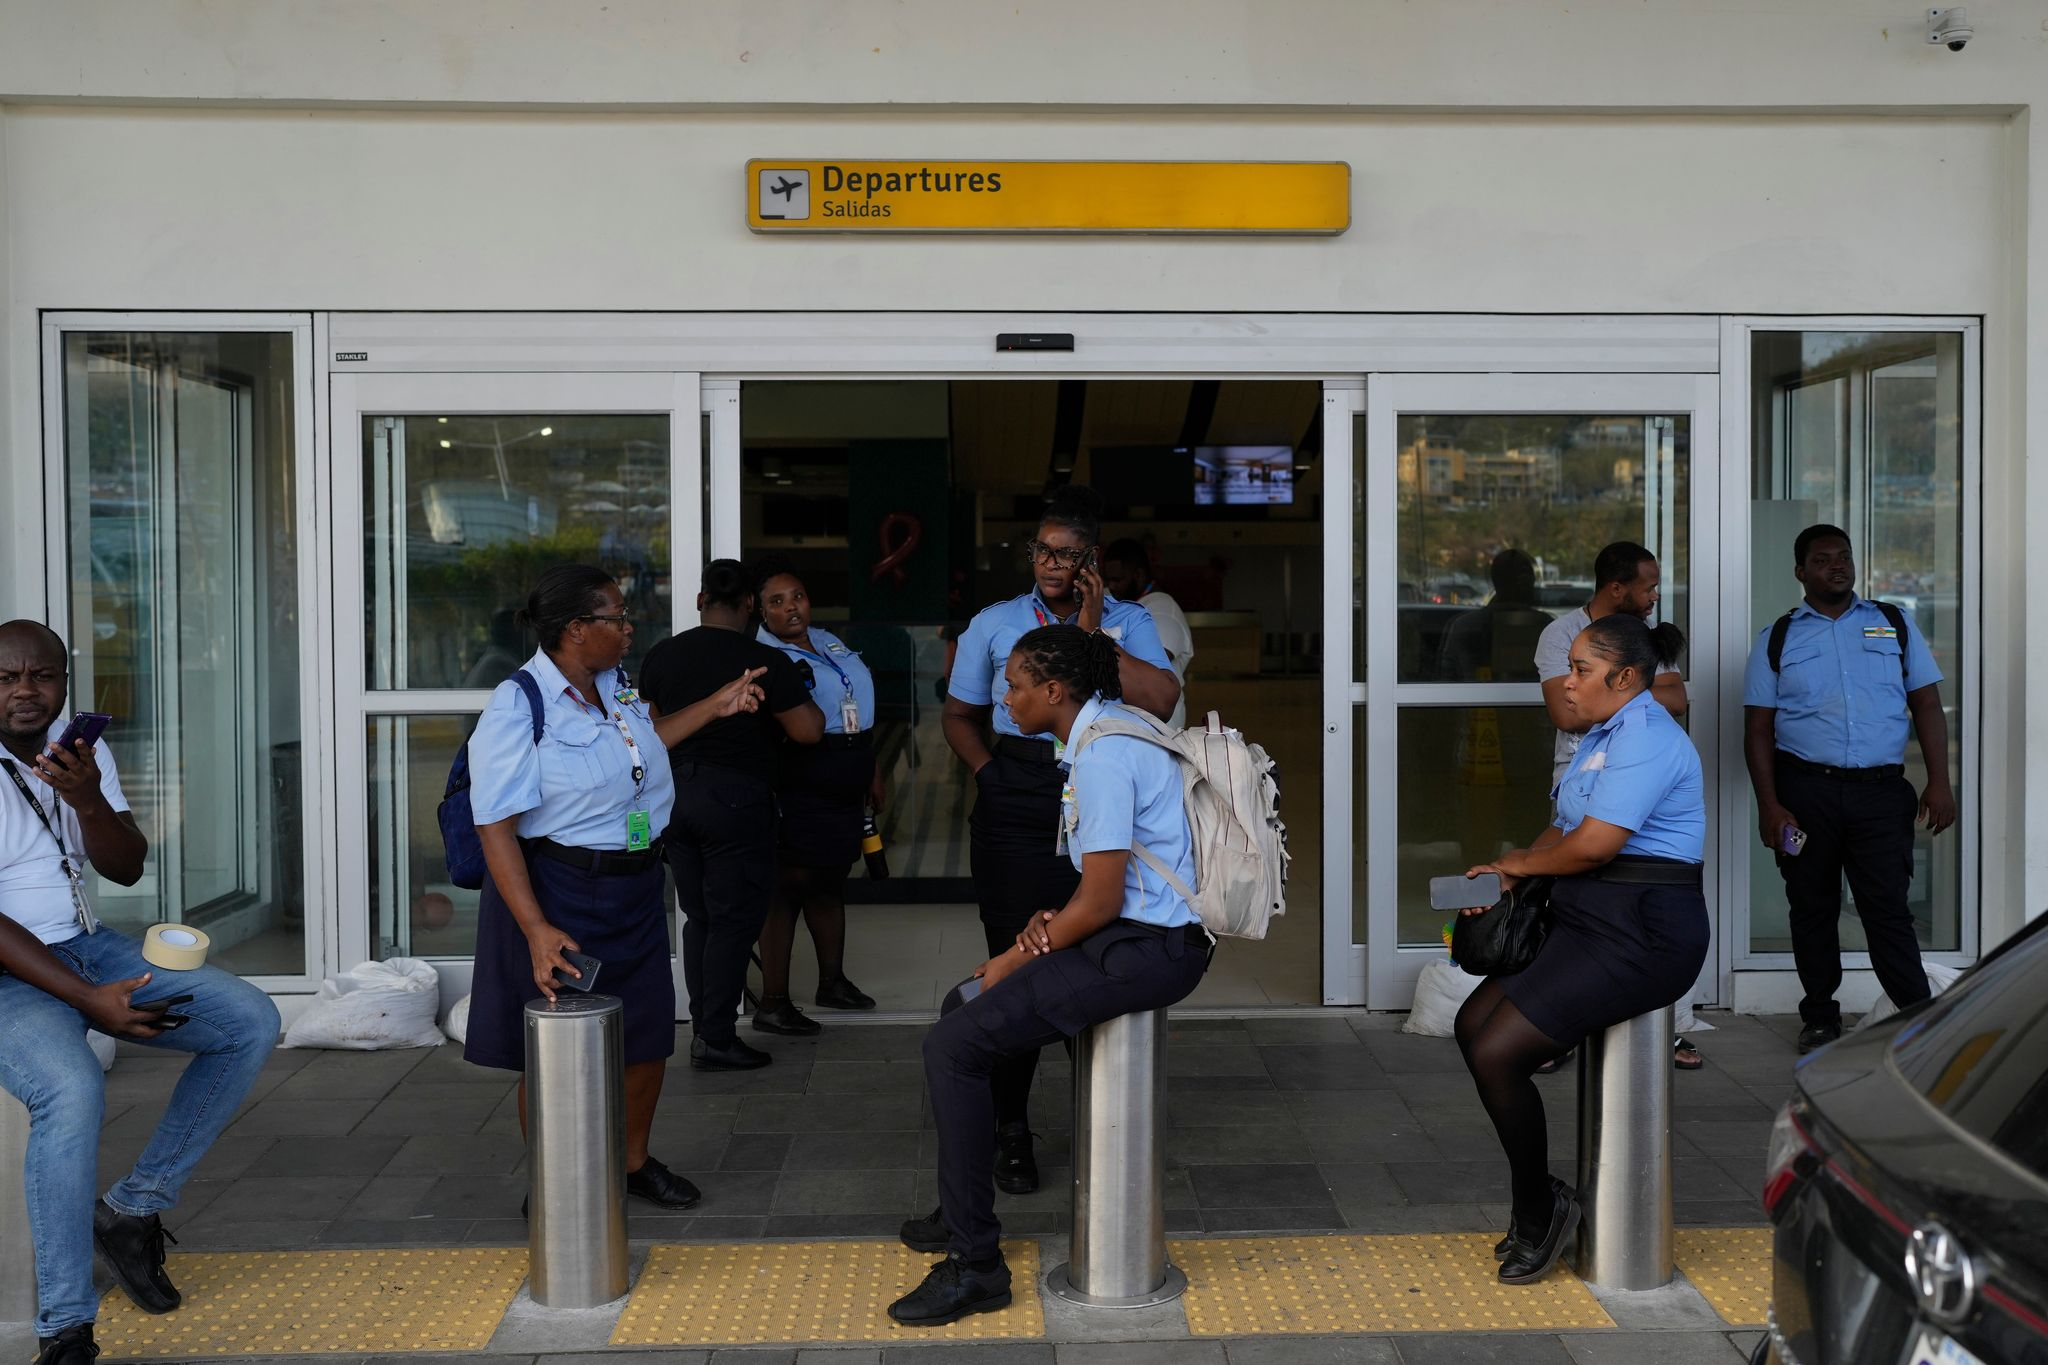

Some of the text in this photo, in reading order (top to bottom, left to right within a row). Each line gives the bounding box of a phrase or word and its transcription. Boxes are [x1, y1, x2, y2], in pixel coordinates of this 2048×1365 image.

[823, 165, 1001, 199] Departures
[822, 200, 891, 217] Salidas
[13, 771, 26, 789] SITA
[31, 799, 44, 815] SITA
